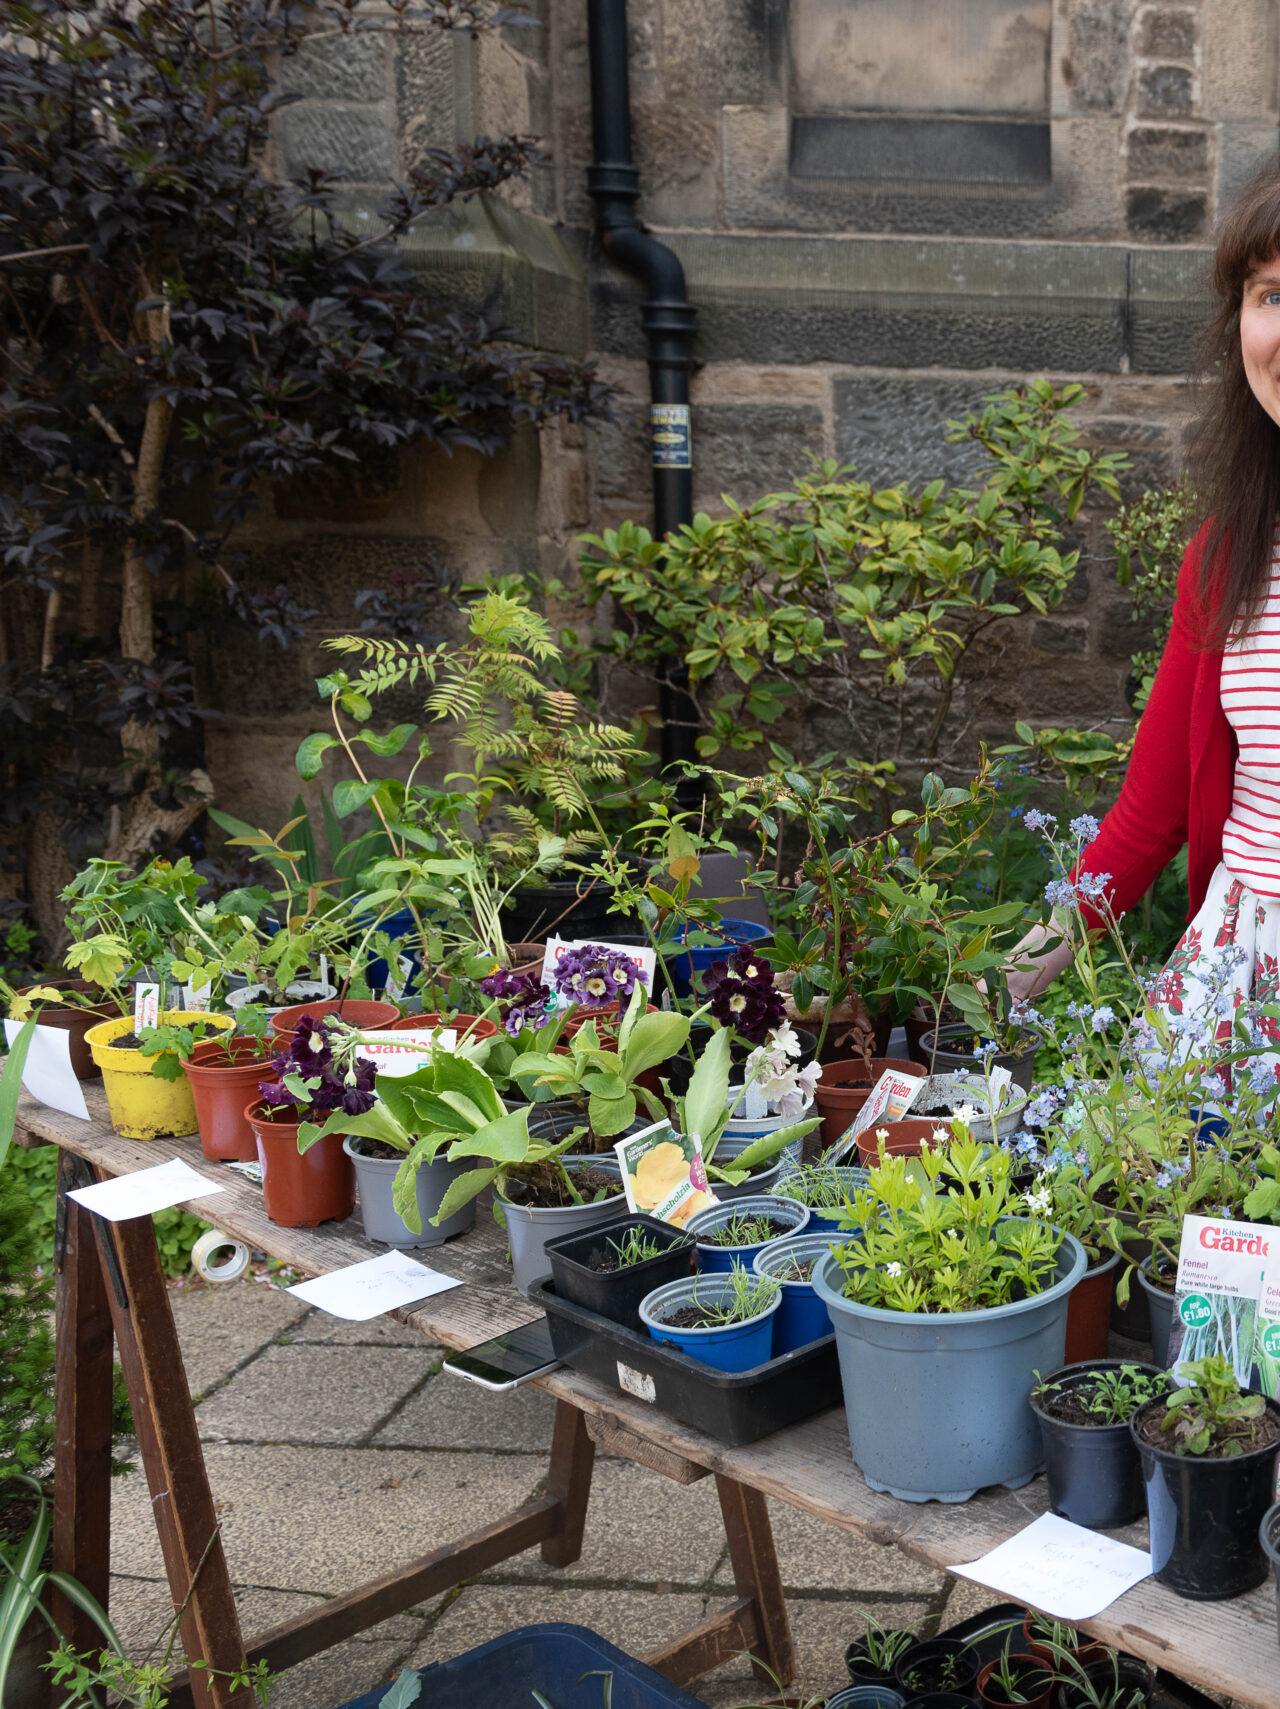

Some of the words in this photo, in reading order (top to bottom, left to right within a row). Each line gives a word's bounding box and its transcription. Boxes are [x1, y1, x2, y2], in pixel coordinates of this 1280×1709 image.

[365, 1038, 432, 1054] Garde
[880, 1076, 912, 1098] Grden
[1222, 1228, 1254, 1239] Kitchen
[1200, 1226, 1269, 1256] Garde
[1182, 1259, 1208, 1269] Fennel
[1194, 1280, 1208, 1288] white
[1189, 1302, 1200, 1310] RRP
[1264, 1307, 1277, 1315] Good
[1184, 1306, 1210, 1321] £1.80
